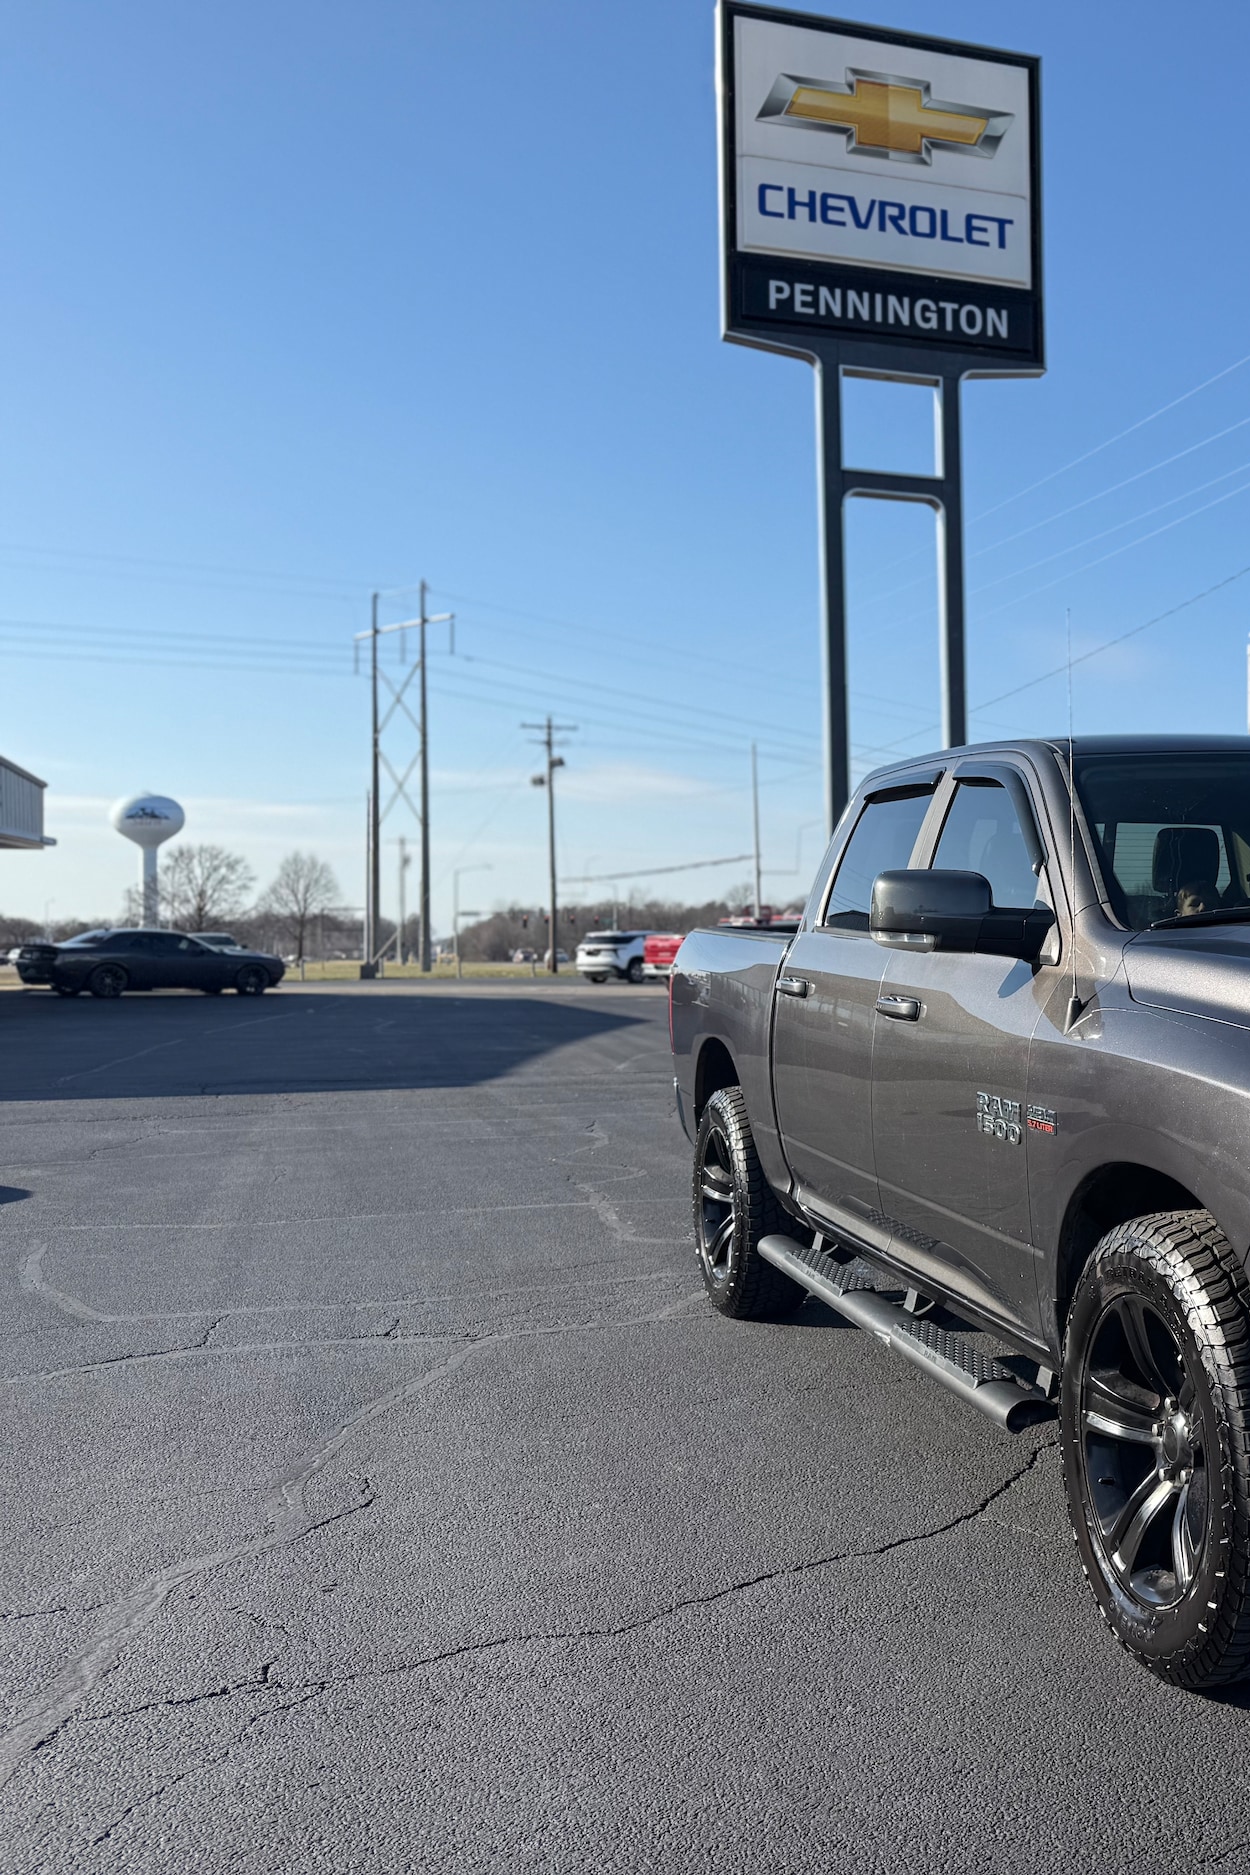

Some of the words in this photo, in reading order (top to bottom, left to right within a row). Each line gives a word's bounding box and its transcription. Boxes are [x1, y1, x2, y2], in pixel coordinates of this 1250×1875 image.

[758, 183, 1014, 249] CHEVROLET
[768, 279, 1009, 339] PENNINGTON
[977, 1091, 1021, 1124] RAM
[977, 1112, 1022, 1145] 1500
